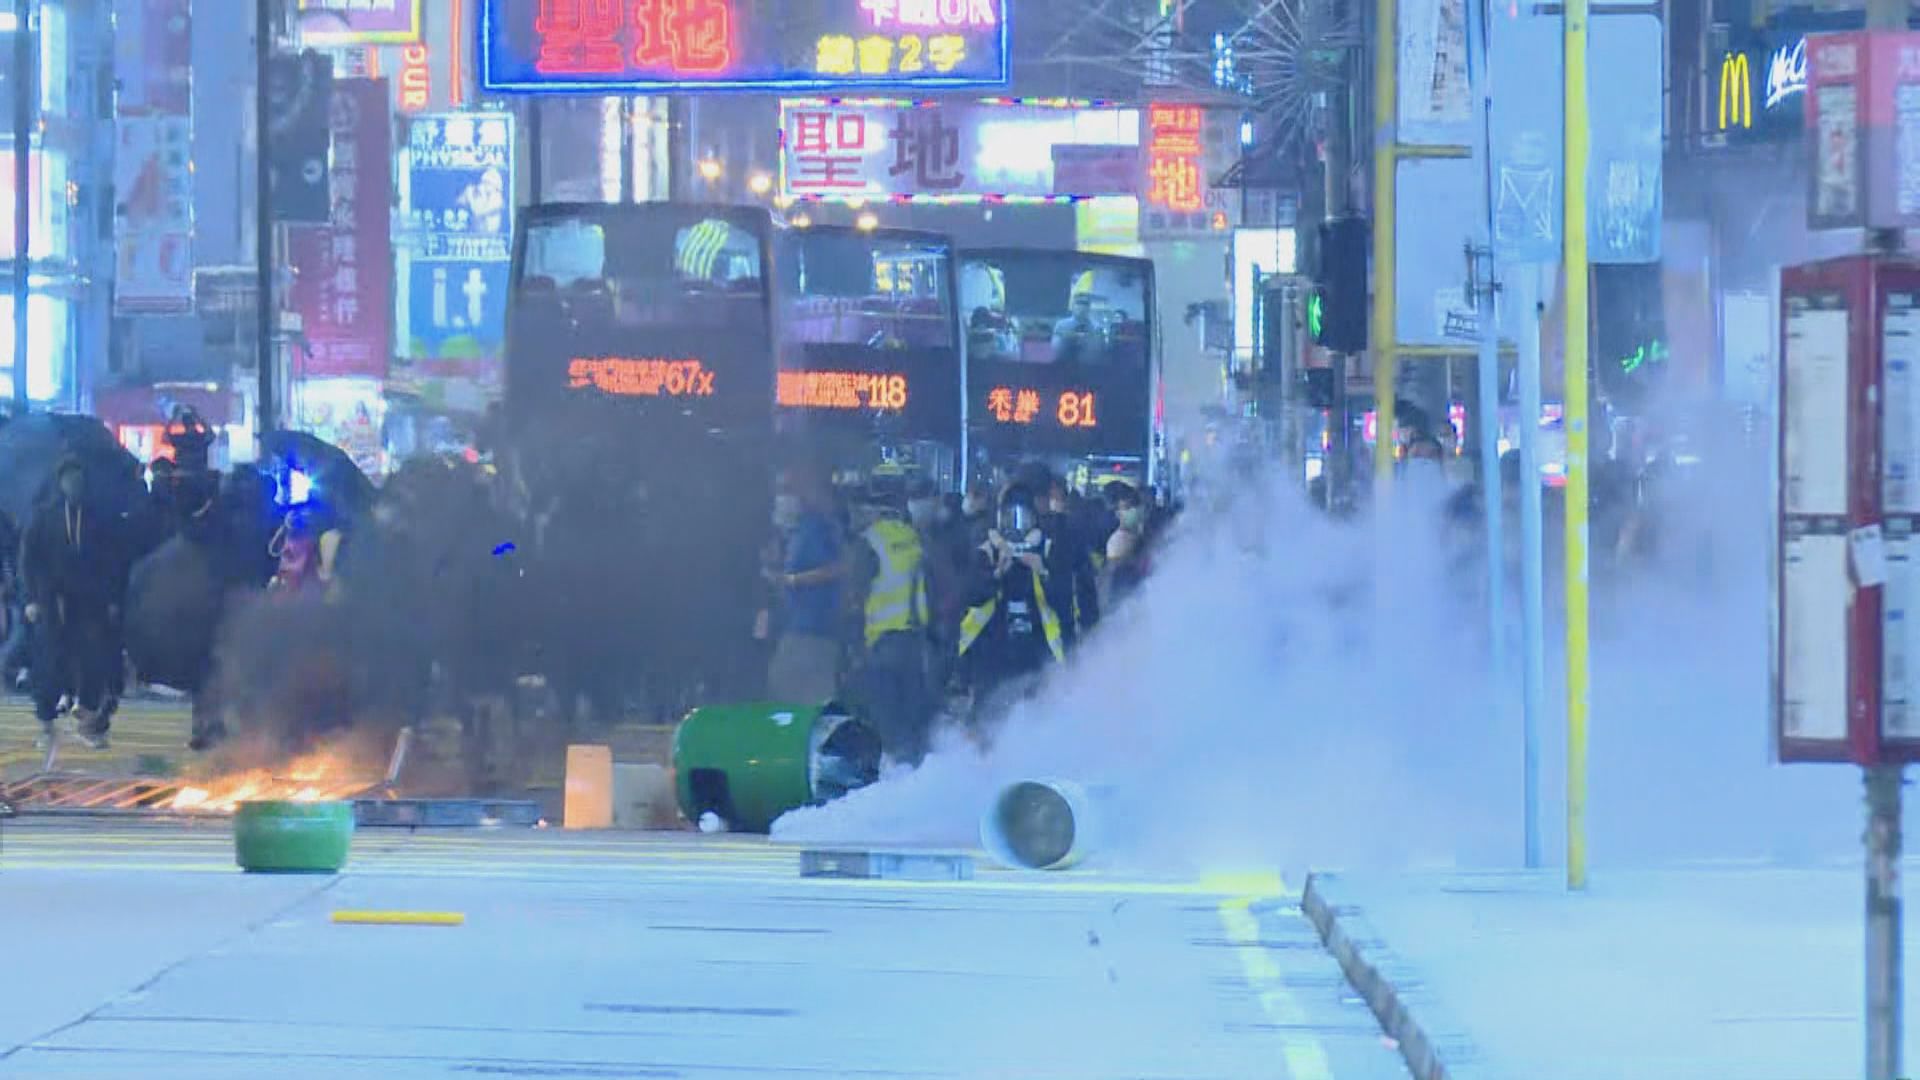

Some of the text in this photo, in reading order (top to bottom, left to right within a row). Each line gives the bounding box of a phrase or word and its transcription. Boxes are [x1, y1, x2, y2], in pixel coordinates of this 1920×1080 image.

[536, 0, 728, 73] 聖地
[791, 108, 966, 190] 聖地
[1148, 104, 1202, 211] 聖地
[432, 267, 487, 329] i.t
[867, 374, 906, 408] 118
[1057, 391, 1097, 427] 81
